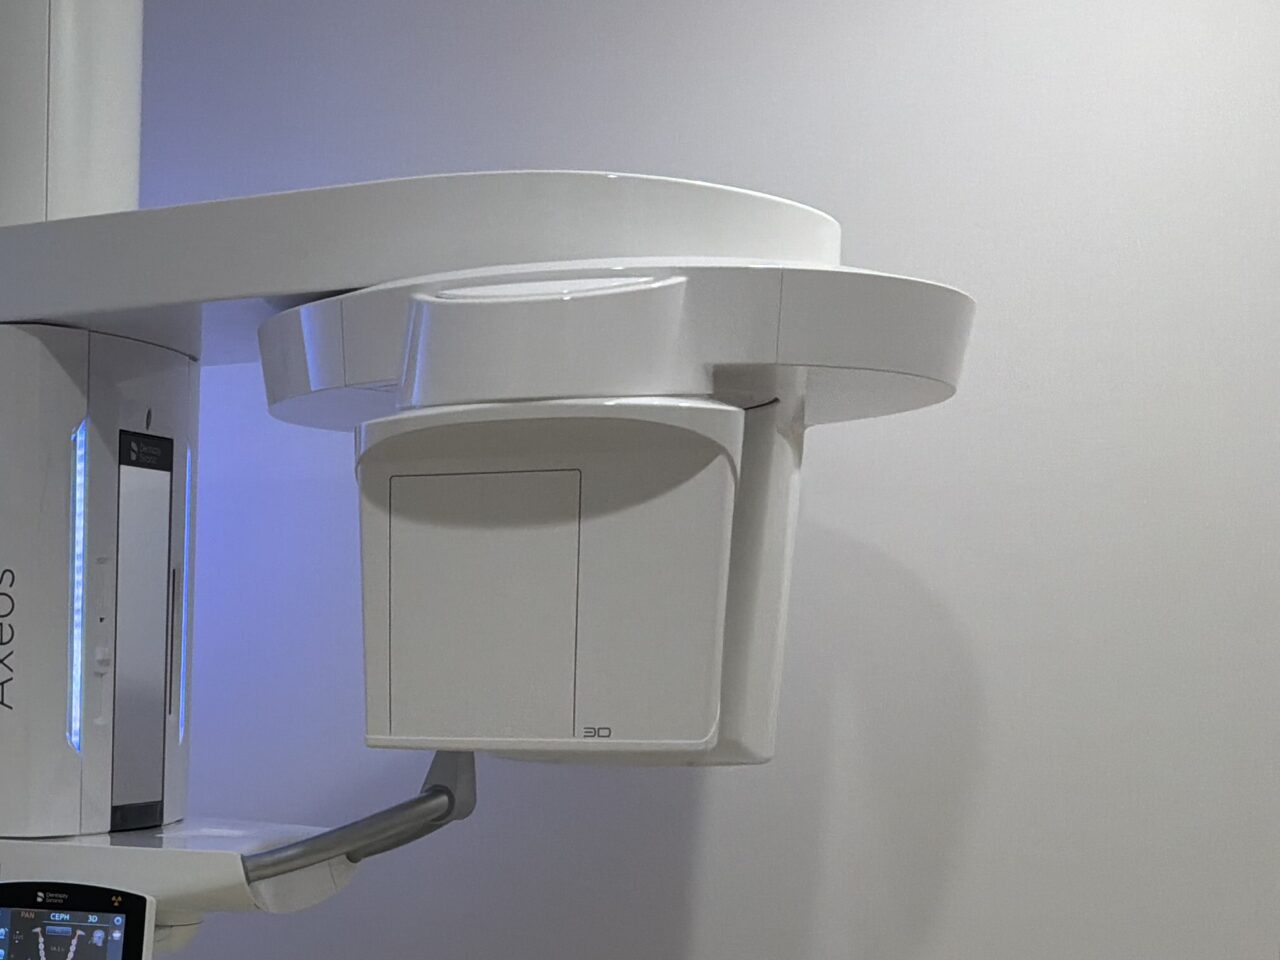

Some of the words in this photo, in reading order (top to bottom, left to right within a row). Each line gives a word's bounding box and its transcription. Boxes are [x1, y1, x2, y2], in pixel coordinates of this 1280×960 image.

[583, 726, 612, 738] 3D
[21, 911, 35, 919] PAN
[50, 912, 70, 921] CEPH
[87, 914, 98, 923] 3D
